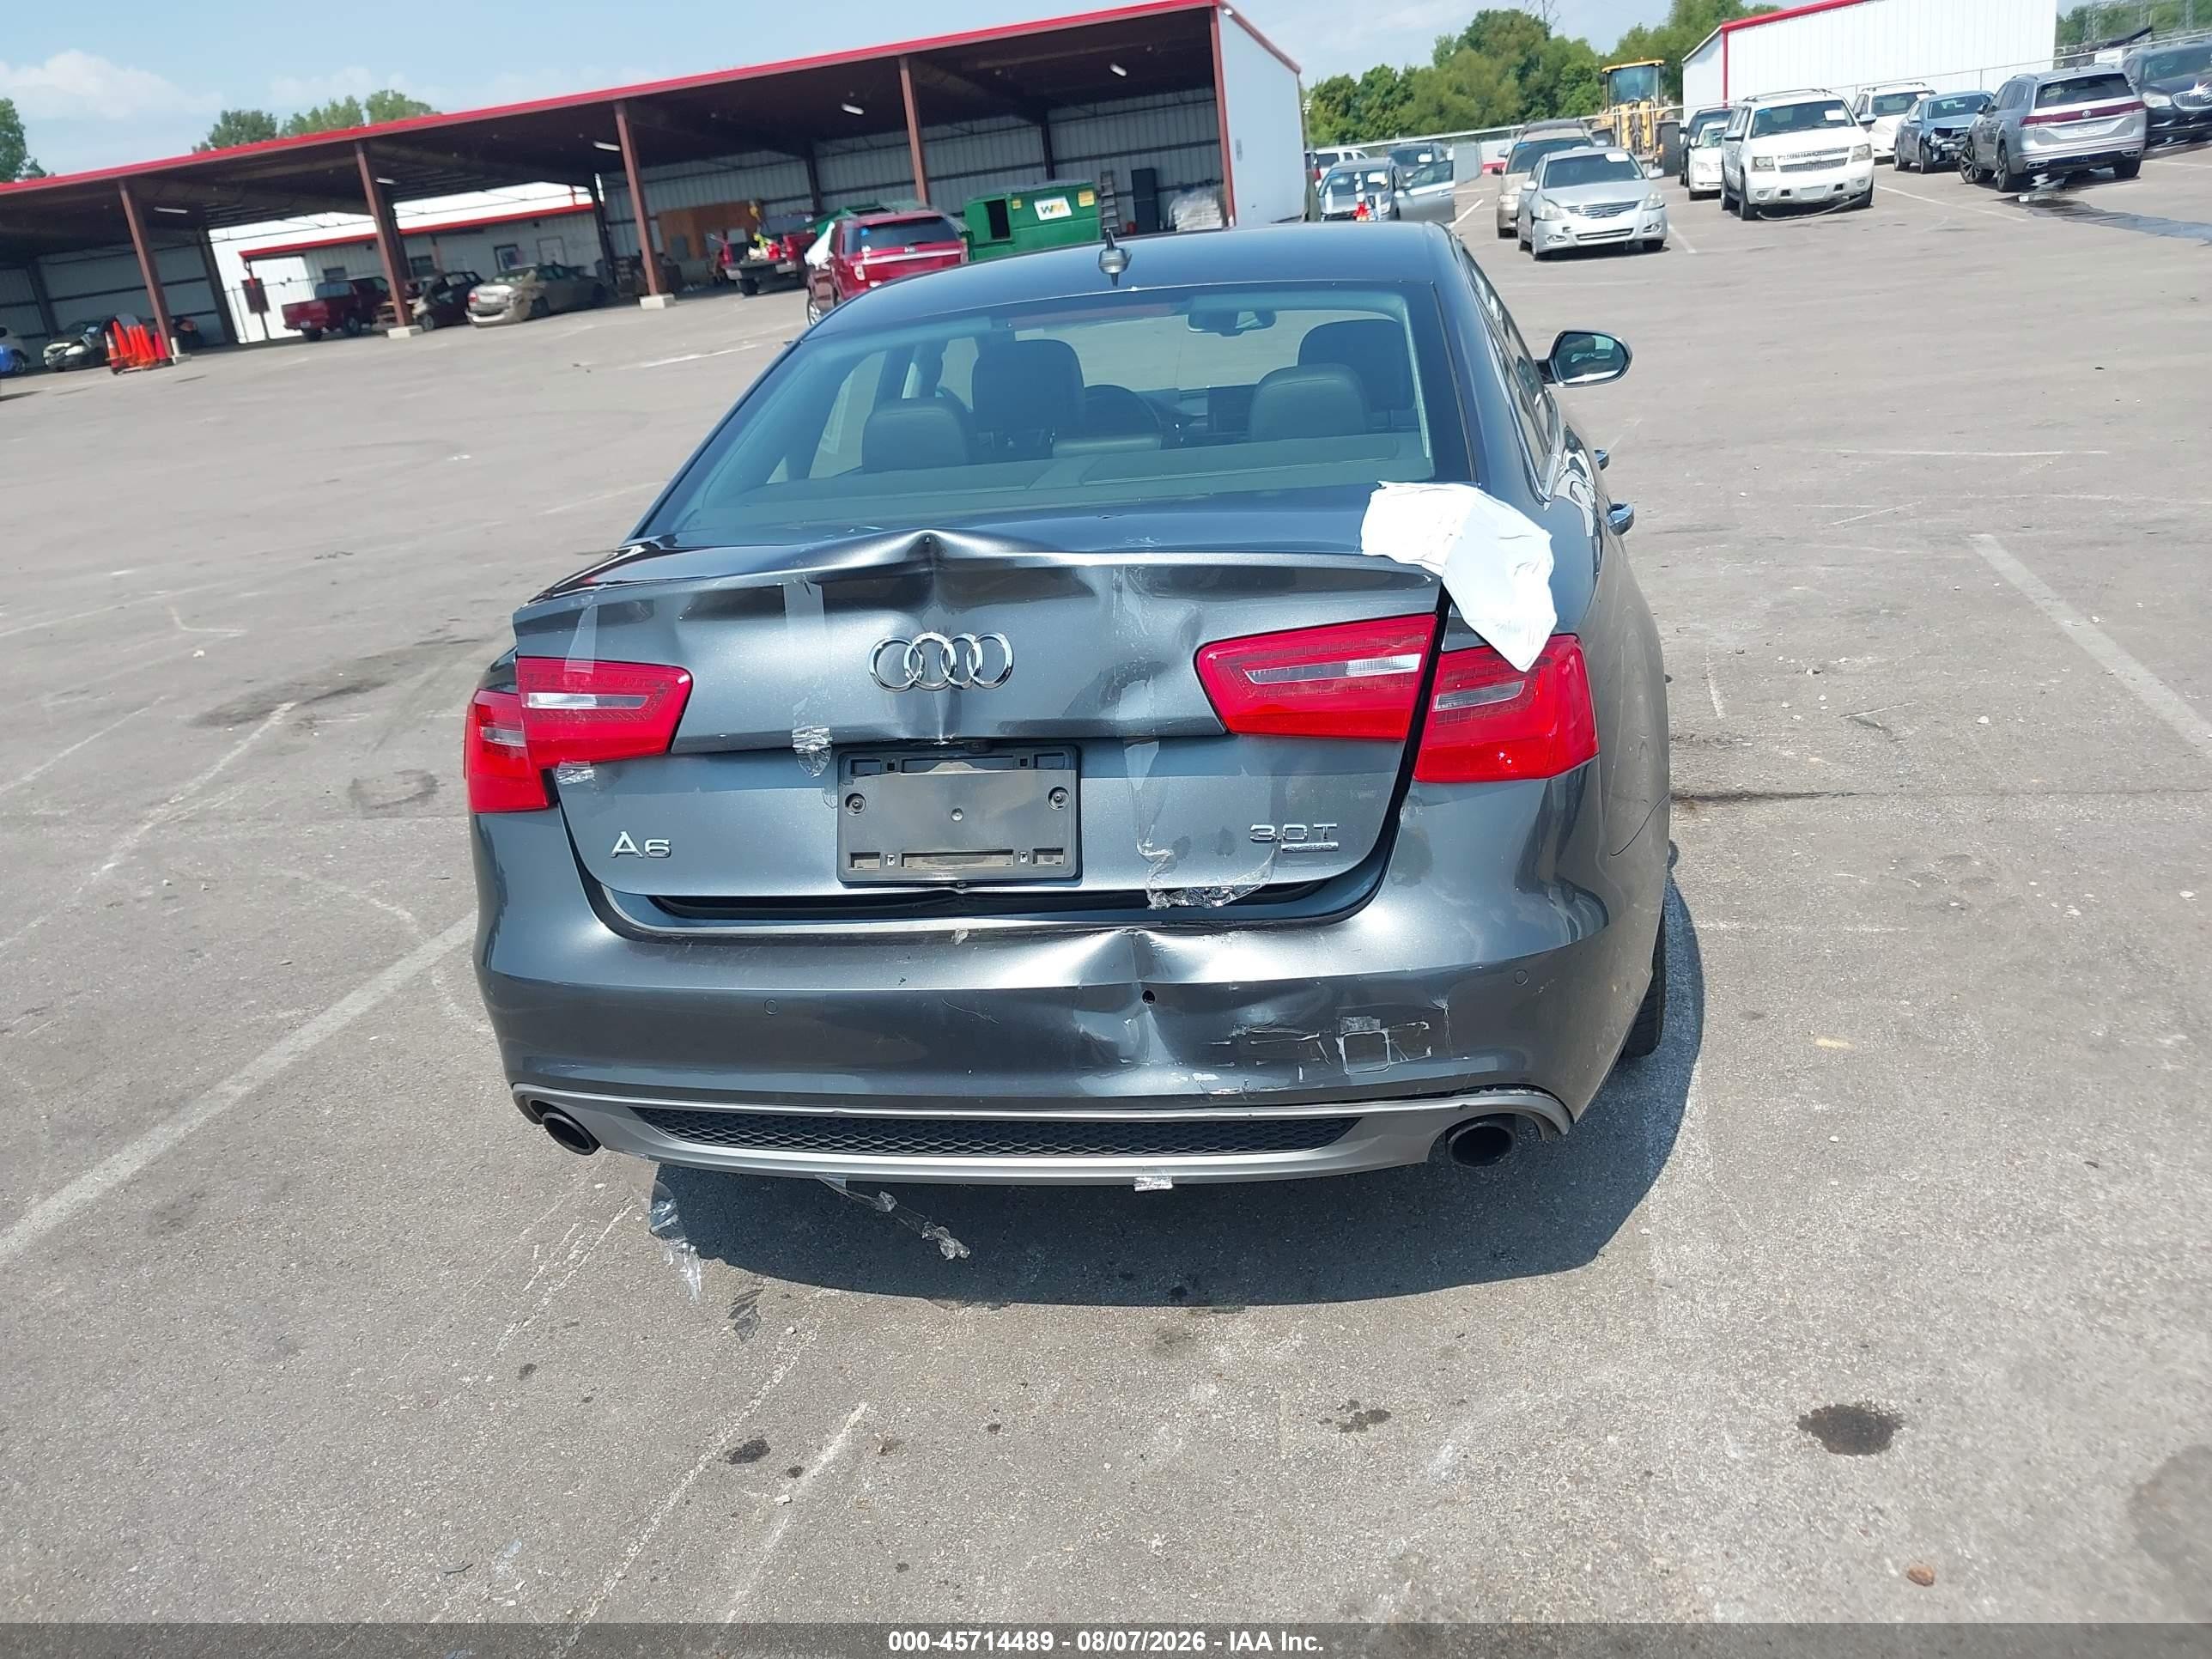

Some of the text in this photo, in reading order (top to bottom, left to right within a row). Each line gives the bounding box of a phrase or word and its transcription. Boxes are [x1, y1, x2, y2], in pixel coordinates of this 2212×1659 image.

[1040, 204, 1066, 214] WM
[1249, 823, 1338, 843] 3.0T
[611, 830, 671, 858] A6
